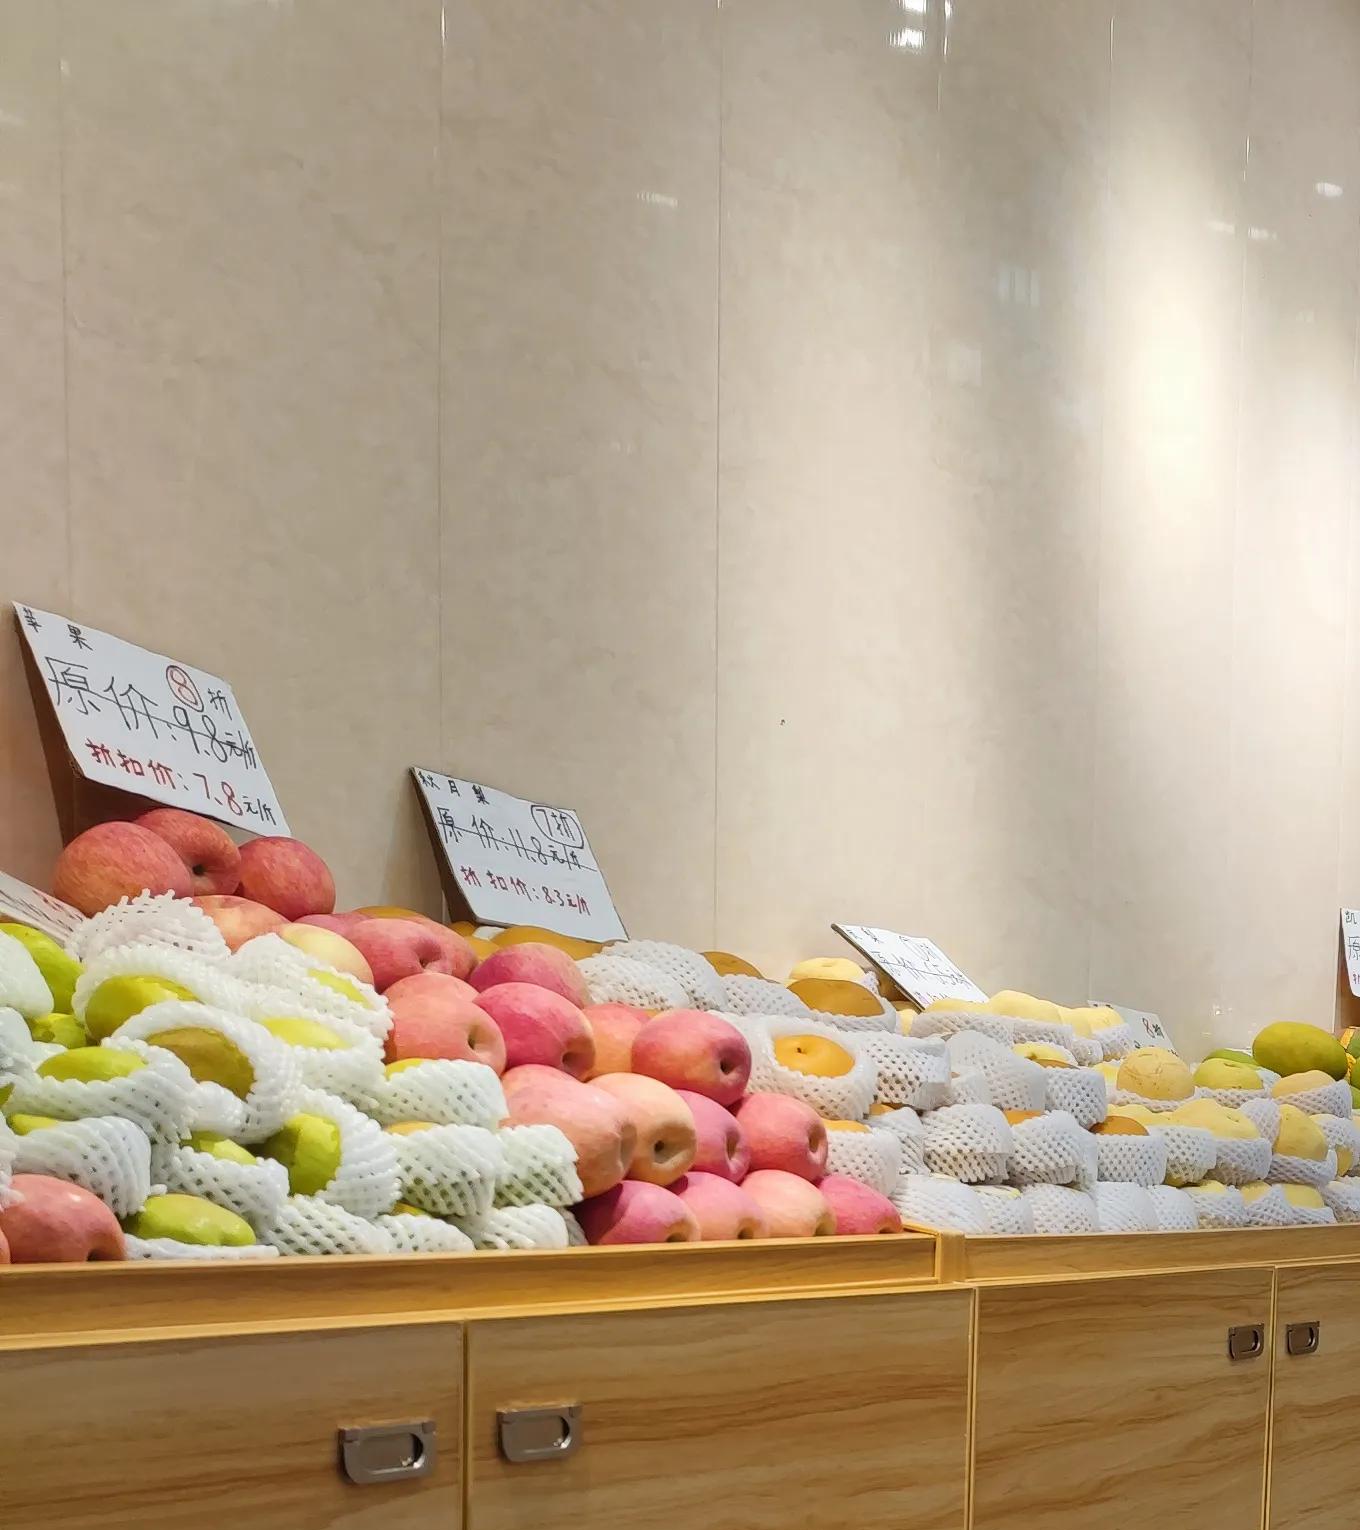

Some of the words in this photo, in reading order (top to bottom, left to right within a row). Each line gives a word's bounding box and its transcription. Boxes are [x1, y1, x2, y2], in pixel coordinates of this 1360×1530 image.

[24, 607, 93, 651] 苹果
[45, 656, 257, 770] 原价:9.8元/斤
[168, 667, 233, 721] 8折
[86, 738, 277, 825] 折扣价:7.8元/斤
[533, 807, 580, 845] 7折
